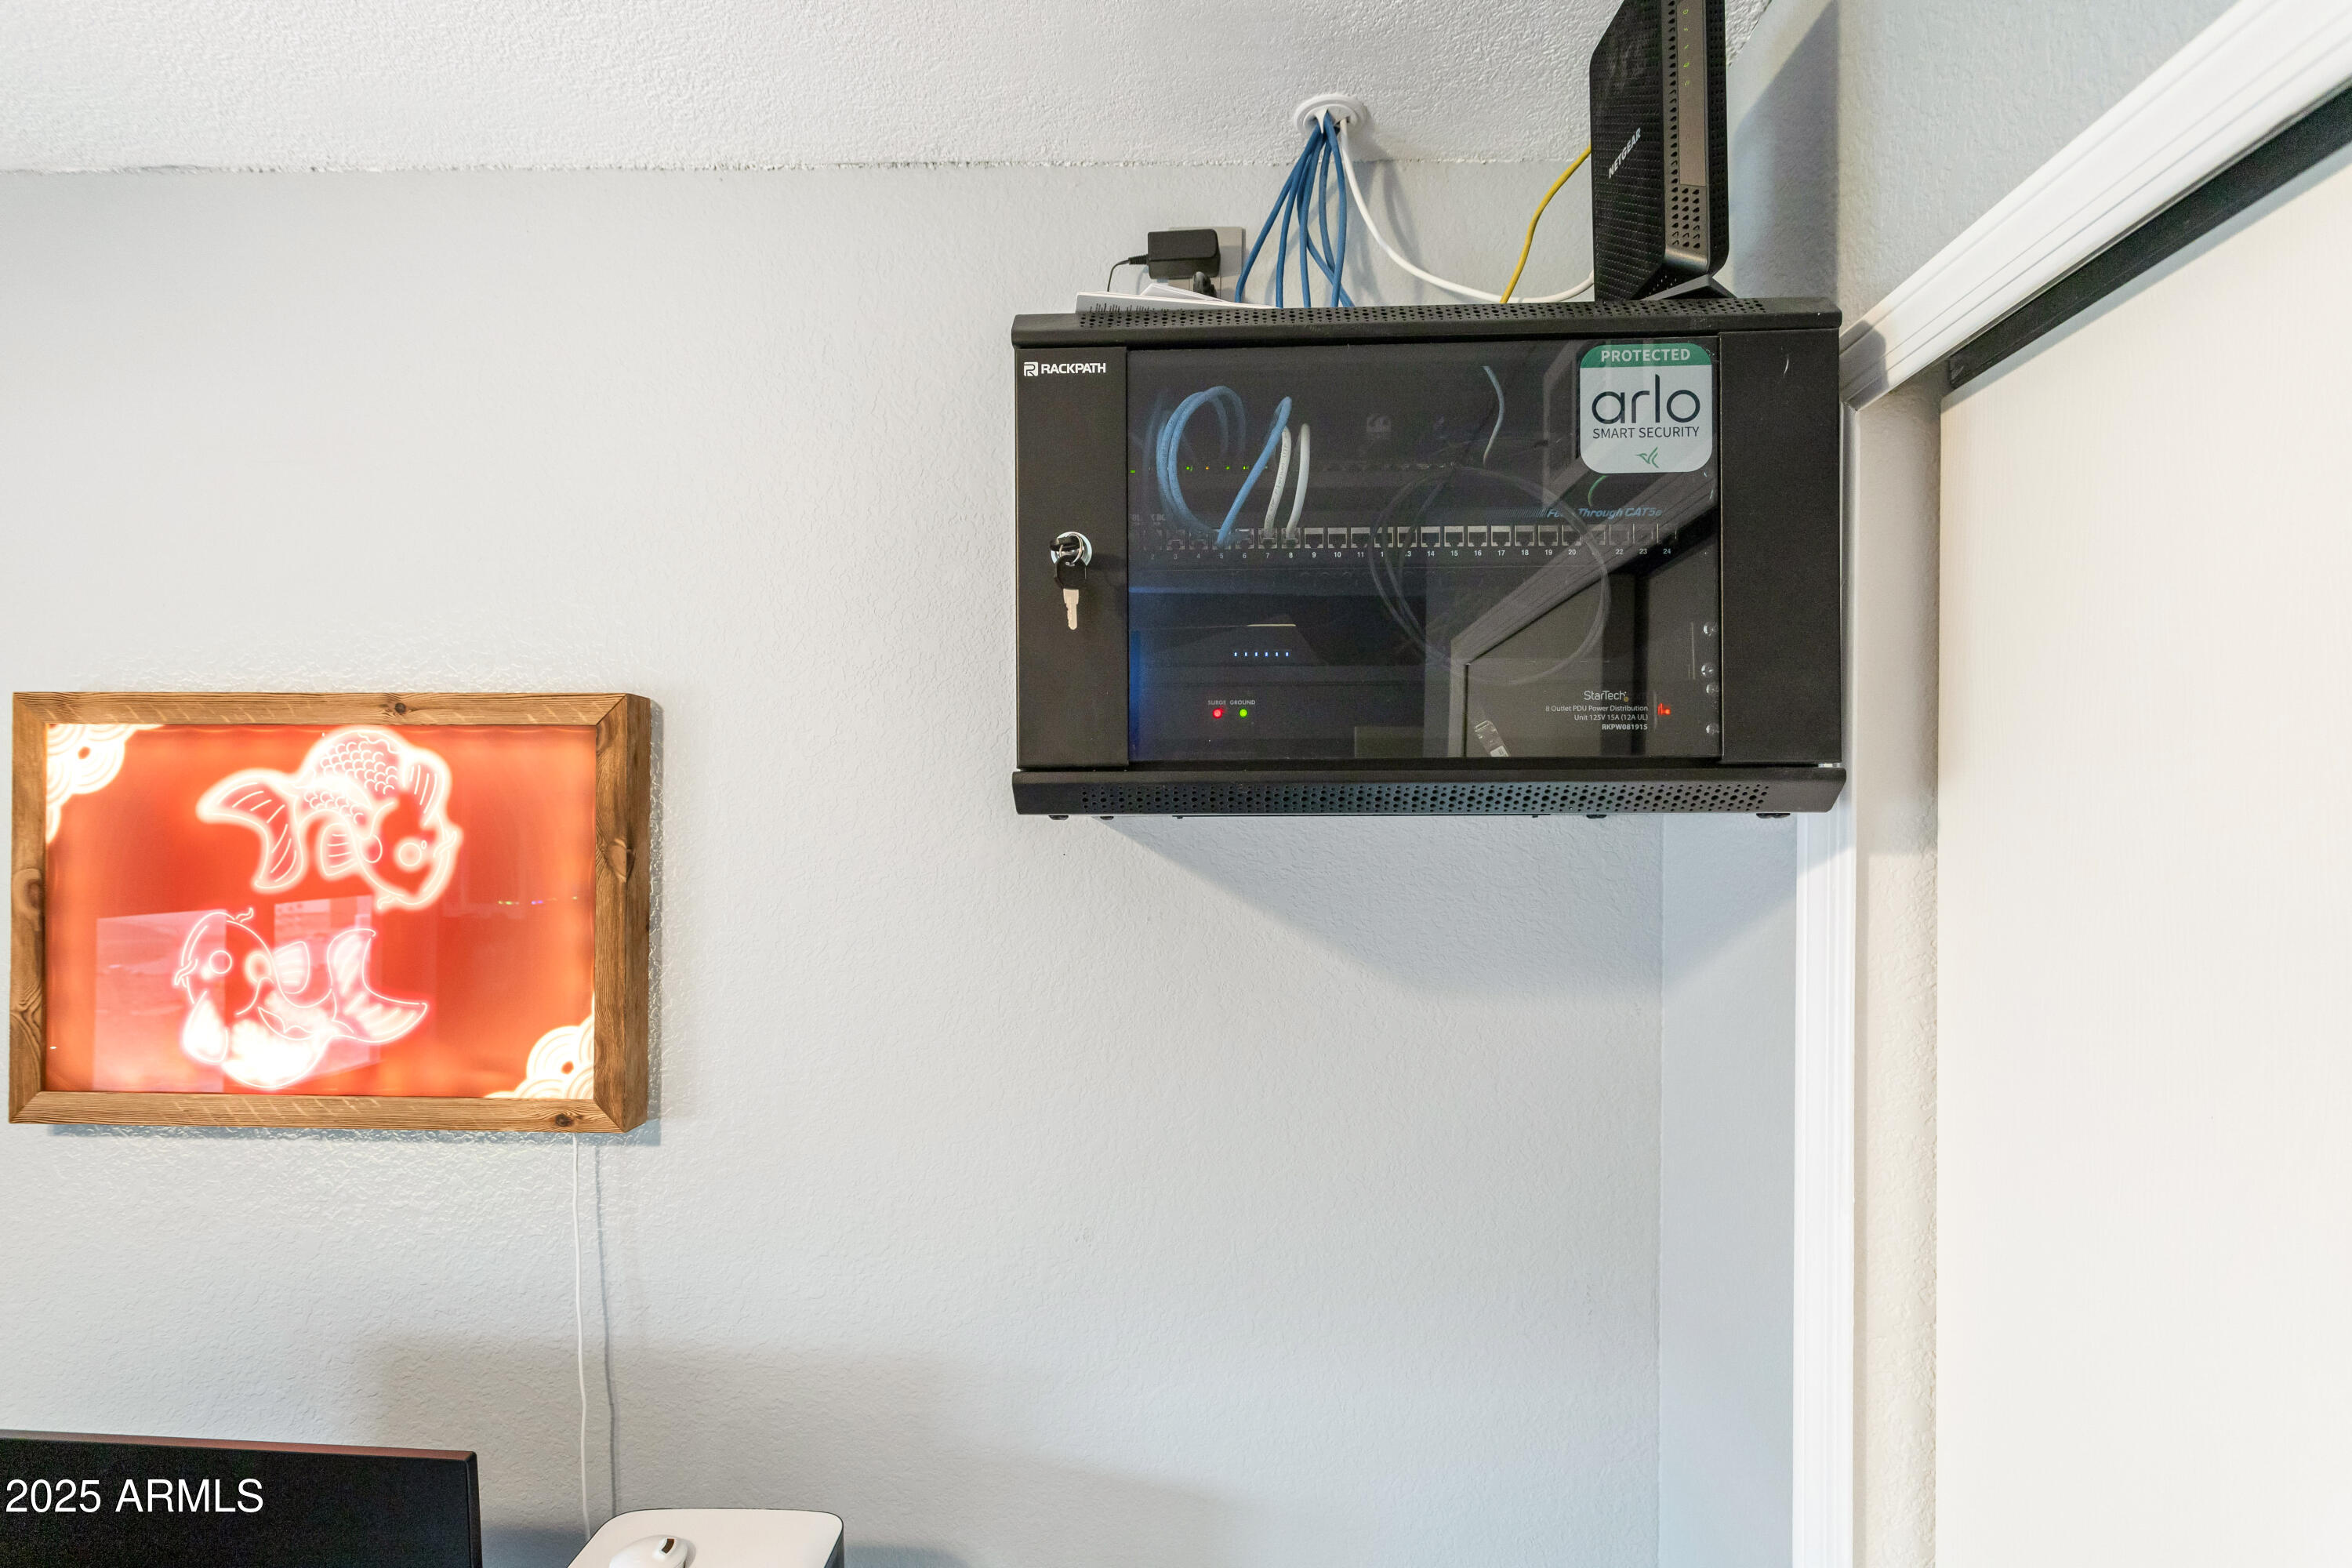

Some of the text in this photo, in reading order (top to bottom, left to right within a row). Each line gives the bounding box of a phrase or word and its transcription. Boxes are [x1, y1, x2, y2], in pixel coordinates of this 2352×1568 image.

[1608, 127, 1641, 180] NETGEAR
[1601, 348, 1690, 362] PROTECTED
[1041, 363, 1106, 374] RACKPATH
[1592, 374, 1700, 425] arlo
[1592, 426, 1700, 439] SMART SECURITY
